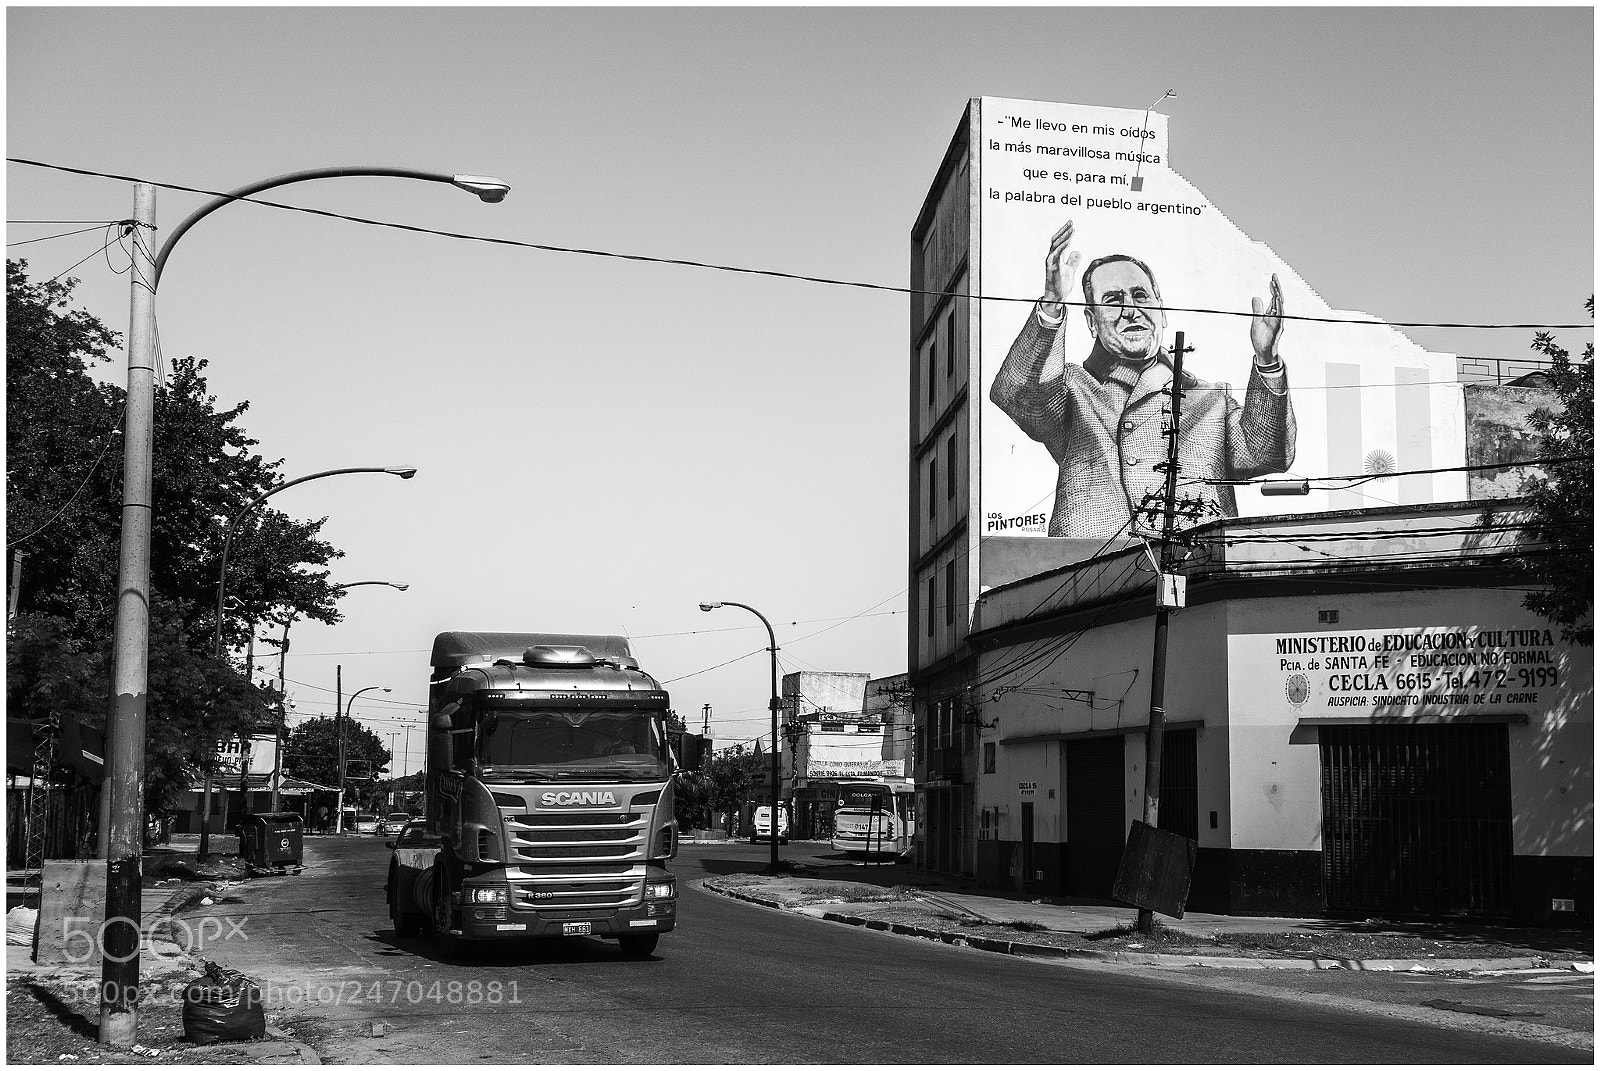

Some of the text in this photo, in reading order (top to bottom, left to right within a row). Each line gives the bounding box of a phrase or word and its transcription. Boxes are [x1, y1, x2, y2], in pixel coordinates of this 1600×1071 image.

[1036, 118, 1067, 132] llevo
[1072, 124, 1088, 134] en
[1093, 124, 1115, 136] mis
[1120, 127, 1156, 139] oídos
[990, 139, 1160, 164] la más maravillosa música
[1023, 168, 1048, 181] que
[1076, 173, 1106, 184] para
[990, 188, 1000, 200] la
[1005, 190, 1056, 203] palabra
[1061, 193, 1081, 206] del
[1087, 198, 1132, 210] pueblo
[987, 512, 1003, 520] LOS
[988, 513, 1046, 532] PINTORES
[1276, 635, 1366, 655] MINISTERIO
[1368, 638, 1382, 652] de
[1383, 632, 1468, 653] EDUCACION
[1478, 629, 1554, 648] CULTURA
[1308, 658, 1320, 671] de
[1325, 656, 1368, 670] SANTA
[1374, 655, 1390, 669] FE
[1410, 652, 1477, 668] EDUCACION
[1481, 652, 1499, 666] NO
[1503, 650, 1554, 665] FORMAL
[1328, 673, 1389, 692] CECLA
[1396, 672, 1432, 690] 6615
[1327, 692, 1538, 707] AUSPICIA: SINDICATO INDUSTRIA DE LA CARNE
[541, 791, 616, 806] SCANIA
